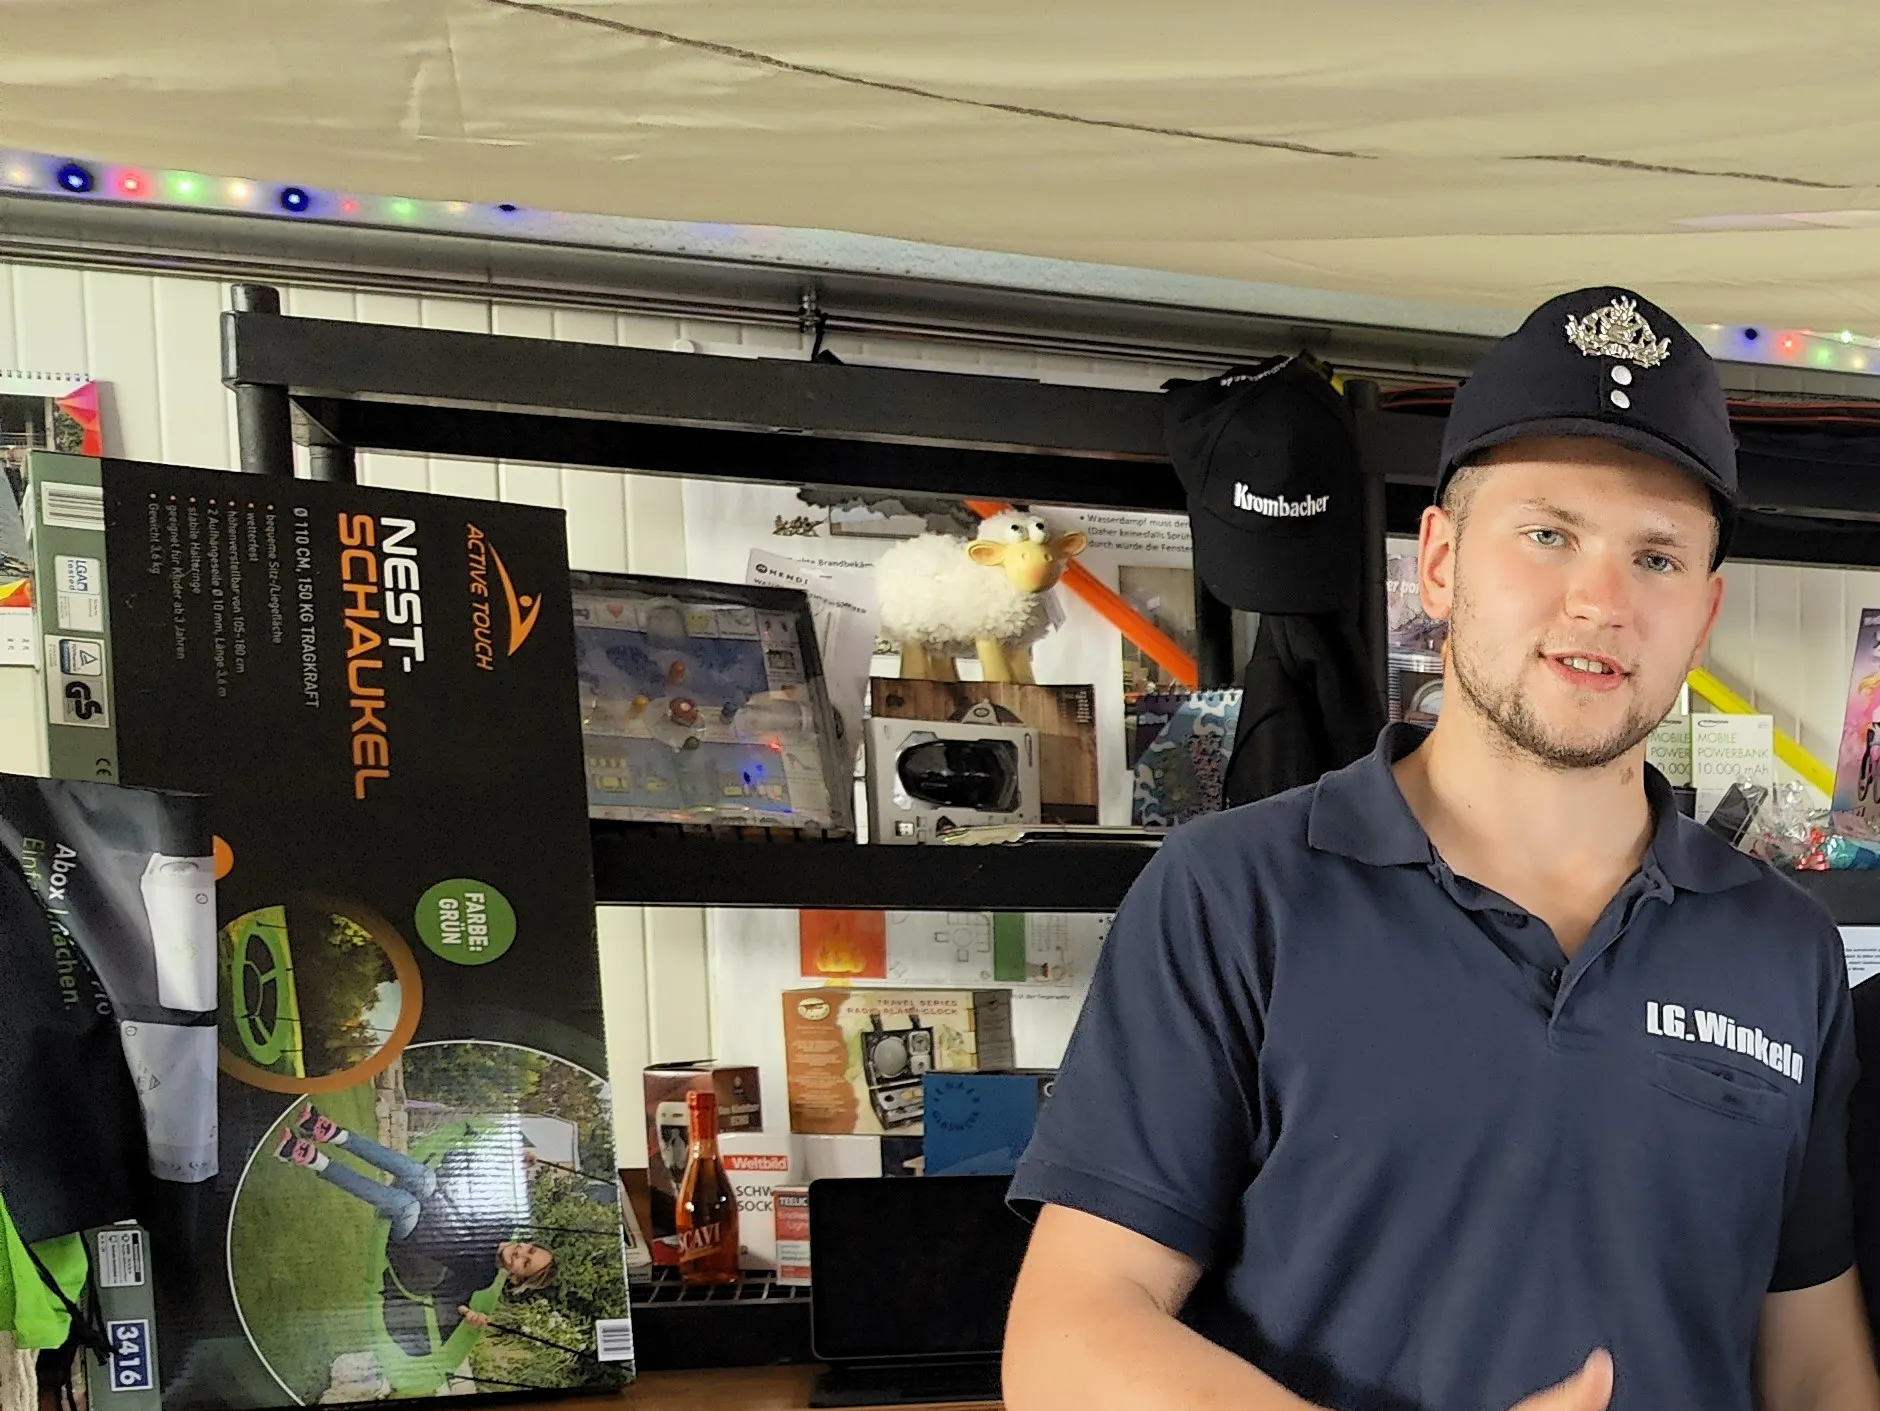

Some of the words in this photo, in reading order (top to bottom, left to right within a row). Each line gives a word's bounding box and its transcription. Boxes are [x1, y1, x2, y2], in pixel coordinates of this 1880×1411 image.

[1233, 481, 1330, 517] Krombacher
[246, 512, 259, 562] wetterfest
[265, 514, 278, 559] bequeme
[294, 522, 310, 543] 110
[67, 559, 76, 591] tested
[294, 547, 311, 572] CM,
[465, 523, 489, 596] ACTIVE
[298, 577, 313, 599] 150
[380, 517, 425, 674] NEST-
[299, 603, 314, 622] KG
[474, 600, 494, 672] TOUCH
[300, 626, 320, 708] TRAGKRAFT
[338, 513, 392, 800] SCHAUKEL
[1697, 732, 1738, 743] MOBILE
[1698, 748, 1769, 759] POWERBANK
[48, 842, 77, 901] Abox
[438, 898, 466, 945] GRÜN
[464, 892, 489, 952] FARBE:
[1646, 1001, 1804, 1085] LG.Winkeln
[732, 1157, 787, 1170] Weltbild
[116, 1326, 142, 1385] 3416
